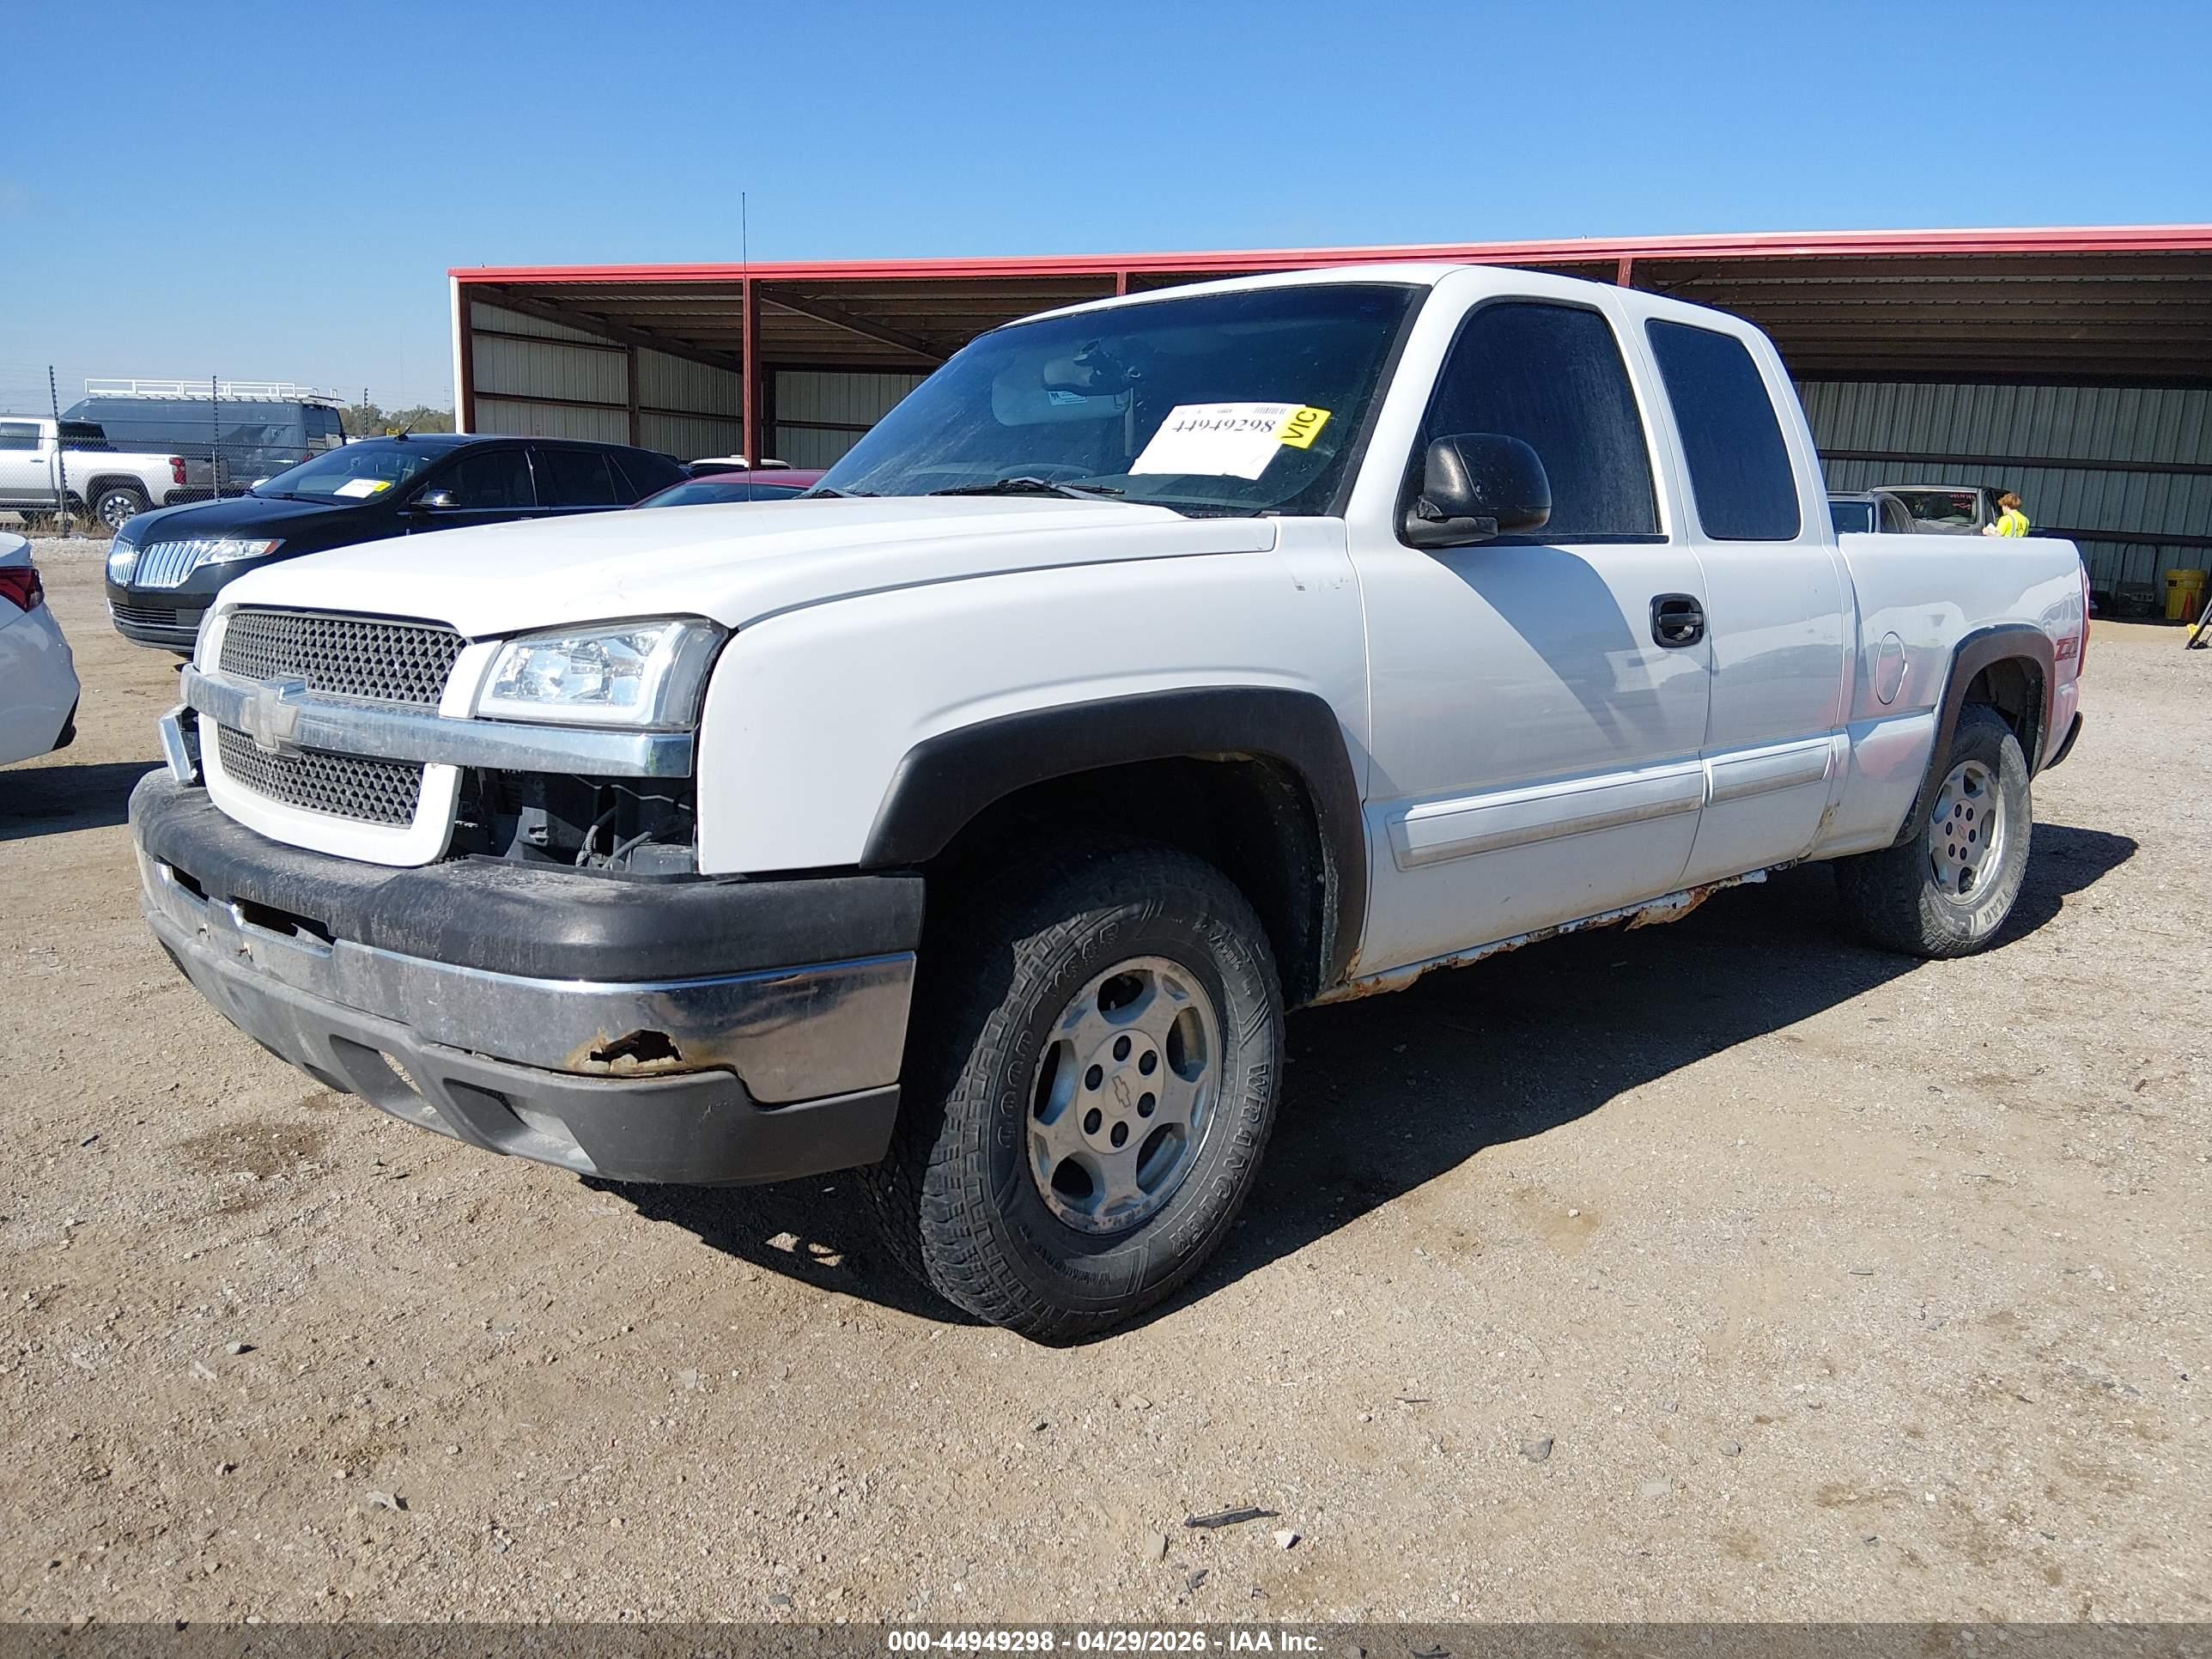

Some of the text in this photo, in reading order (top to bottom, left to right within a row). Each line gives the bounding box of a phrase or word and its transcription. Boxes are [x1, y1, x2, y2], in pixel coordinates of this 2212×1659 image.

[1171, 417, 1277, 434] 44949298
[1281, 410, 1318, 441] VIC
[1168, 1063, 1269, 1258] WRANGLER
